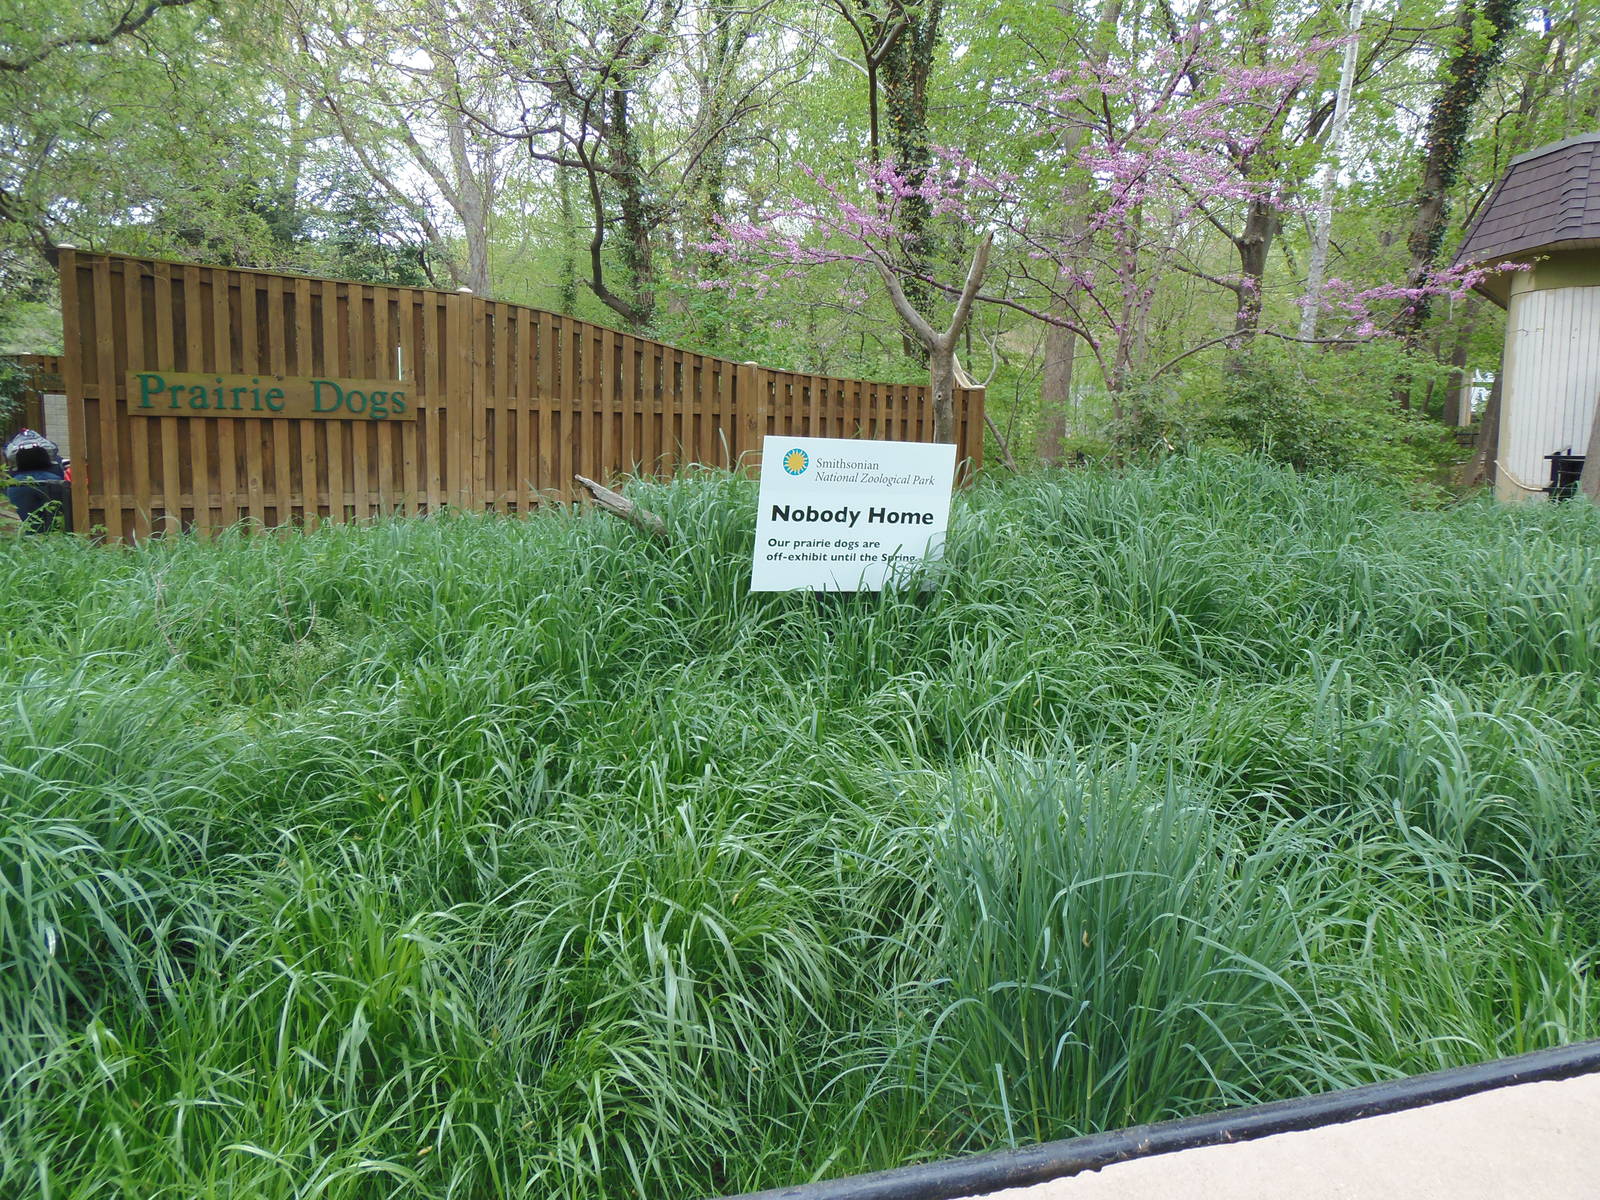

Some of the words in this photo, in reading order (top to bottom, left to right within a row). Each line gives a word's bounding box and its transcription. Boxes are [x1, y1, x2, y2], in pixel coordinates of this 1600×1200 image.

[136, 374, 285, 411] Prairie
[311, 380, 407, 419] Dogs
[816, 458, 879, 470] Smithsonian
[815, 472, 858, 483] National
[860, 473, 910, 487] Zoological
[912, 475, 935, 486] Park
[771, 505, 861, 528] Nobody
[868, 507, 934, 525] Home
[768, 538, 790, 548] Our
[794, 539, 831, 549] prairie
[834, 539, 859, 550] dogs
[862, 541, 880, 549] are
[766, 552, 828, 562] off-exhibit
[830, 553, 856, 562] until
[860, 553, 878, 562] the
